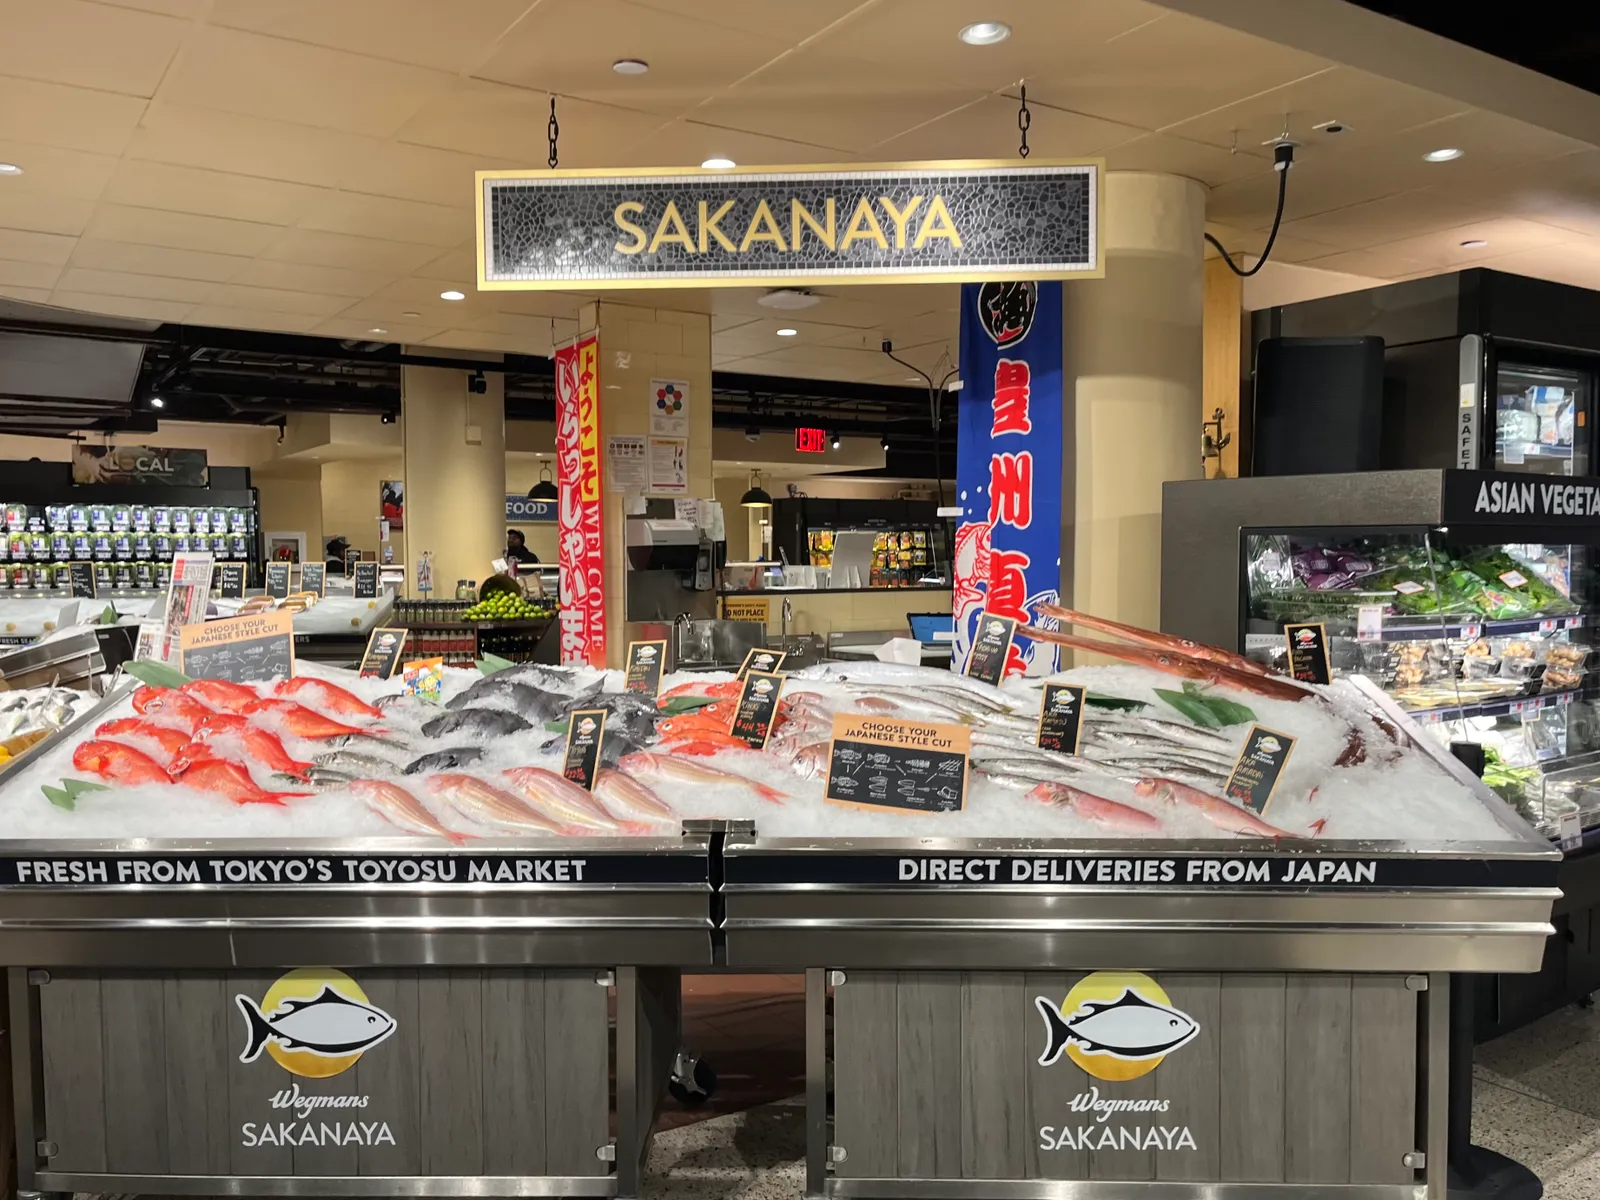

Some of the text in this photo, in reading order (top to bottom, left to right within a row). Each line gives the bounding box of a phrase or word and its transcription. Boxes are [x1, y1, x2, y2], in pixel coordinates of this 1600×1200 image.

[613, 194, 963, 255] SAKANAYA
[800, 428, 823, 450] EXIT
[505, 502, 548, 515] FOOD
[1475, 481, 1600, 516] ASIAN VEGETA
[584, 502, 604, 652] WELCOME
[746, 609, 765, 617] PLACE
[191, 623, 279, 645] JAPANESE STYLE CUT
[204, 618, 266, 635] CHOOSE YOUR
[845, 728, 953, 748] JAPANESE STYLE CUT
[862, 721, 937, 738] CHOOSE YOUR
[17, 860, 587, 883] FRESH FROM TOKYO'S TOYOSU MARKET
[899, 859, 1377, 883] DIRECT DELIVERIES FROM JAPAN
[268, 1083, 370, 1119] Wegmans
[1066, 1086, 1171, 1123] Wegmans
[241, 1122, 396, 1147] SAKANAYA
[1039, 1126, 1198, 1150] SAKANAYA
